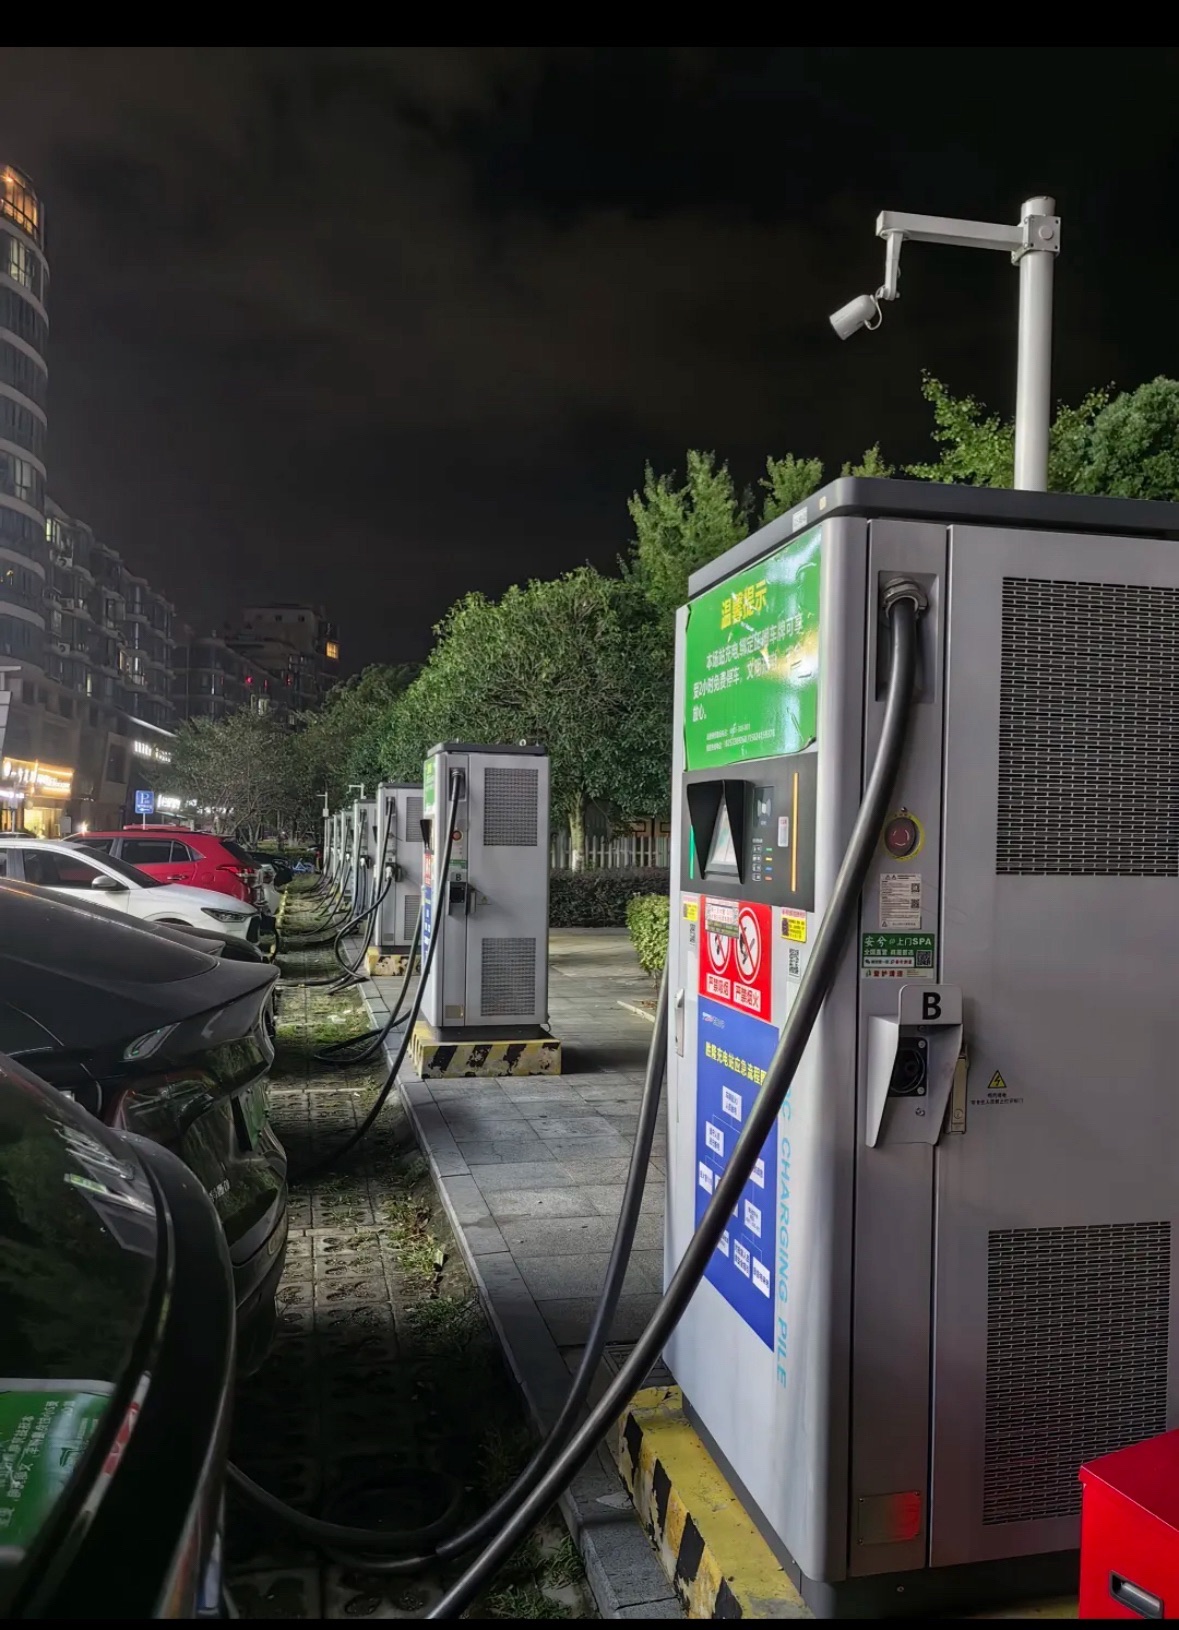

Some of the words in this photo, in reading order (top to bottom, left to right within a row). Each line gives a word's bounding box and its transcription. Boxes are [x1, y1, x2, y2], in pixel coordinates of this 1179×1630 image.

[720, 579, 768, 630] 温馨提示
[141, 793, 150, 804] P
[897, 937, 932, 947] 上门SPA
[708, 976, 729, 997] 严禁吸烟
[735, 985, 759, 1008] 严禁烟火
[922, 991, 943, 1020] B
[778, 1137, 791, 1305] CHARGING
[776, 1316, 789, 1388] PILE
